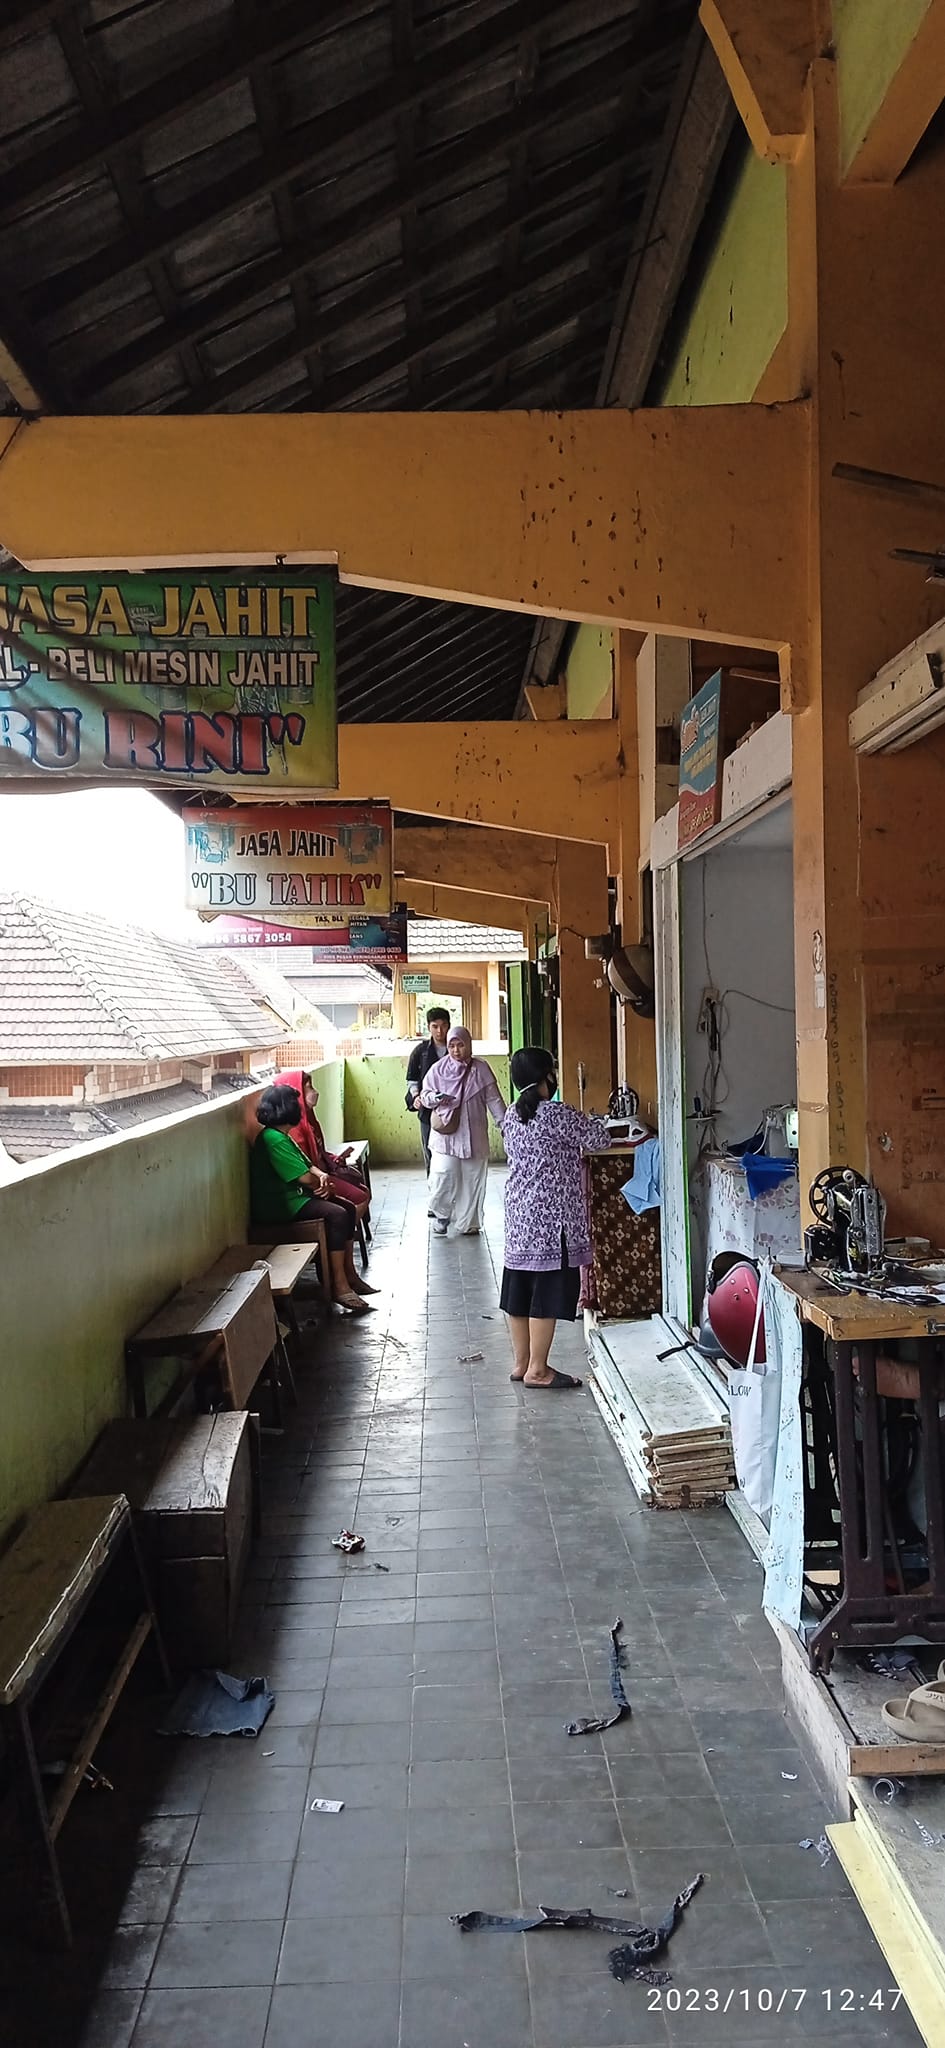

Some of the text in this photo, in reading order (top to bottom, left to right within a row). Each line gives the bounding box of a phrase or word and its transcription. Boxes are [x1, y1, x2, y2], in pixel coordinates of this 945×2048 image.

[151, 585, 319, 637] JAHIT
[47, 647, 115, 684] BELI
[124, 651, 221, 686] MESIN
[228, 651, 320, 687] JAHIT
[103, 710, 306, 774] RINI"
[236, 829, 339, 857] JASA JAHIT
[233, 933, 261, 944] 5867
[264, 932, 292, 943] 3054
